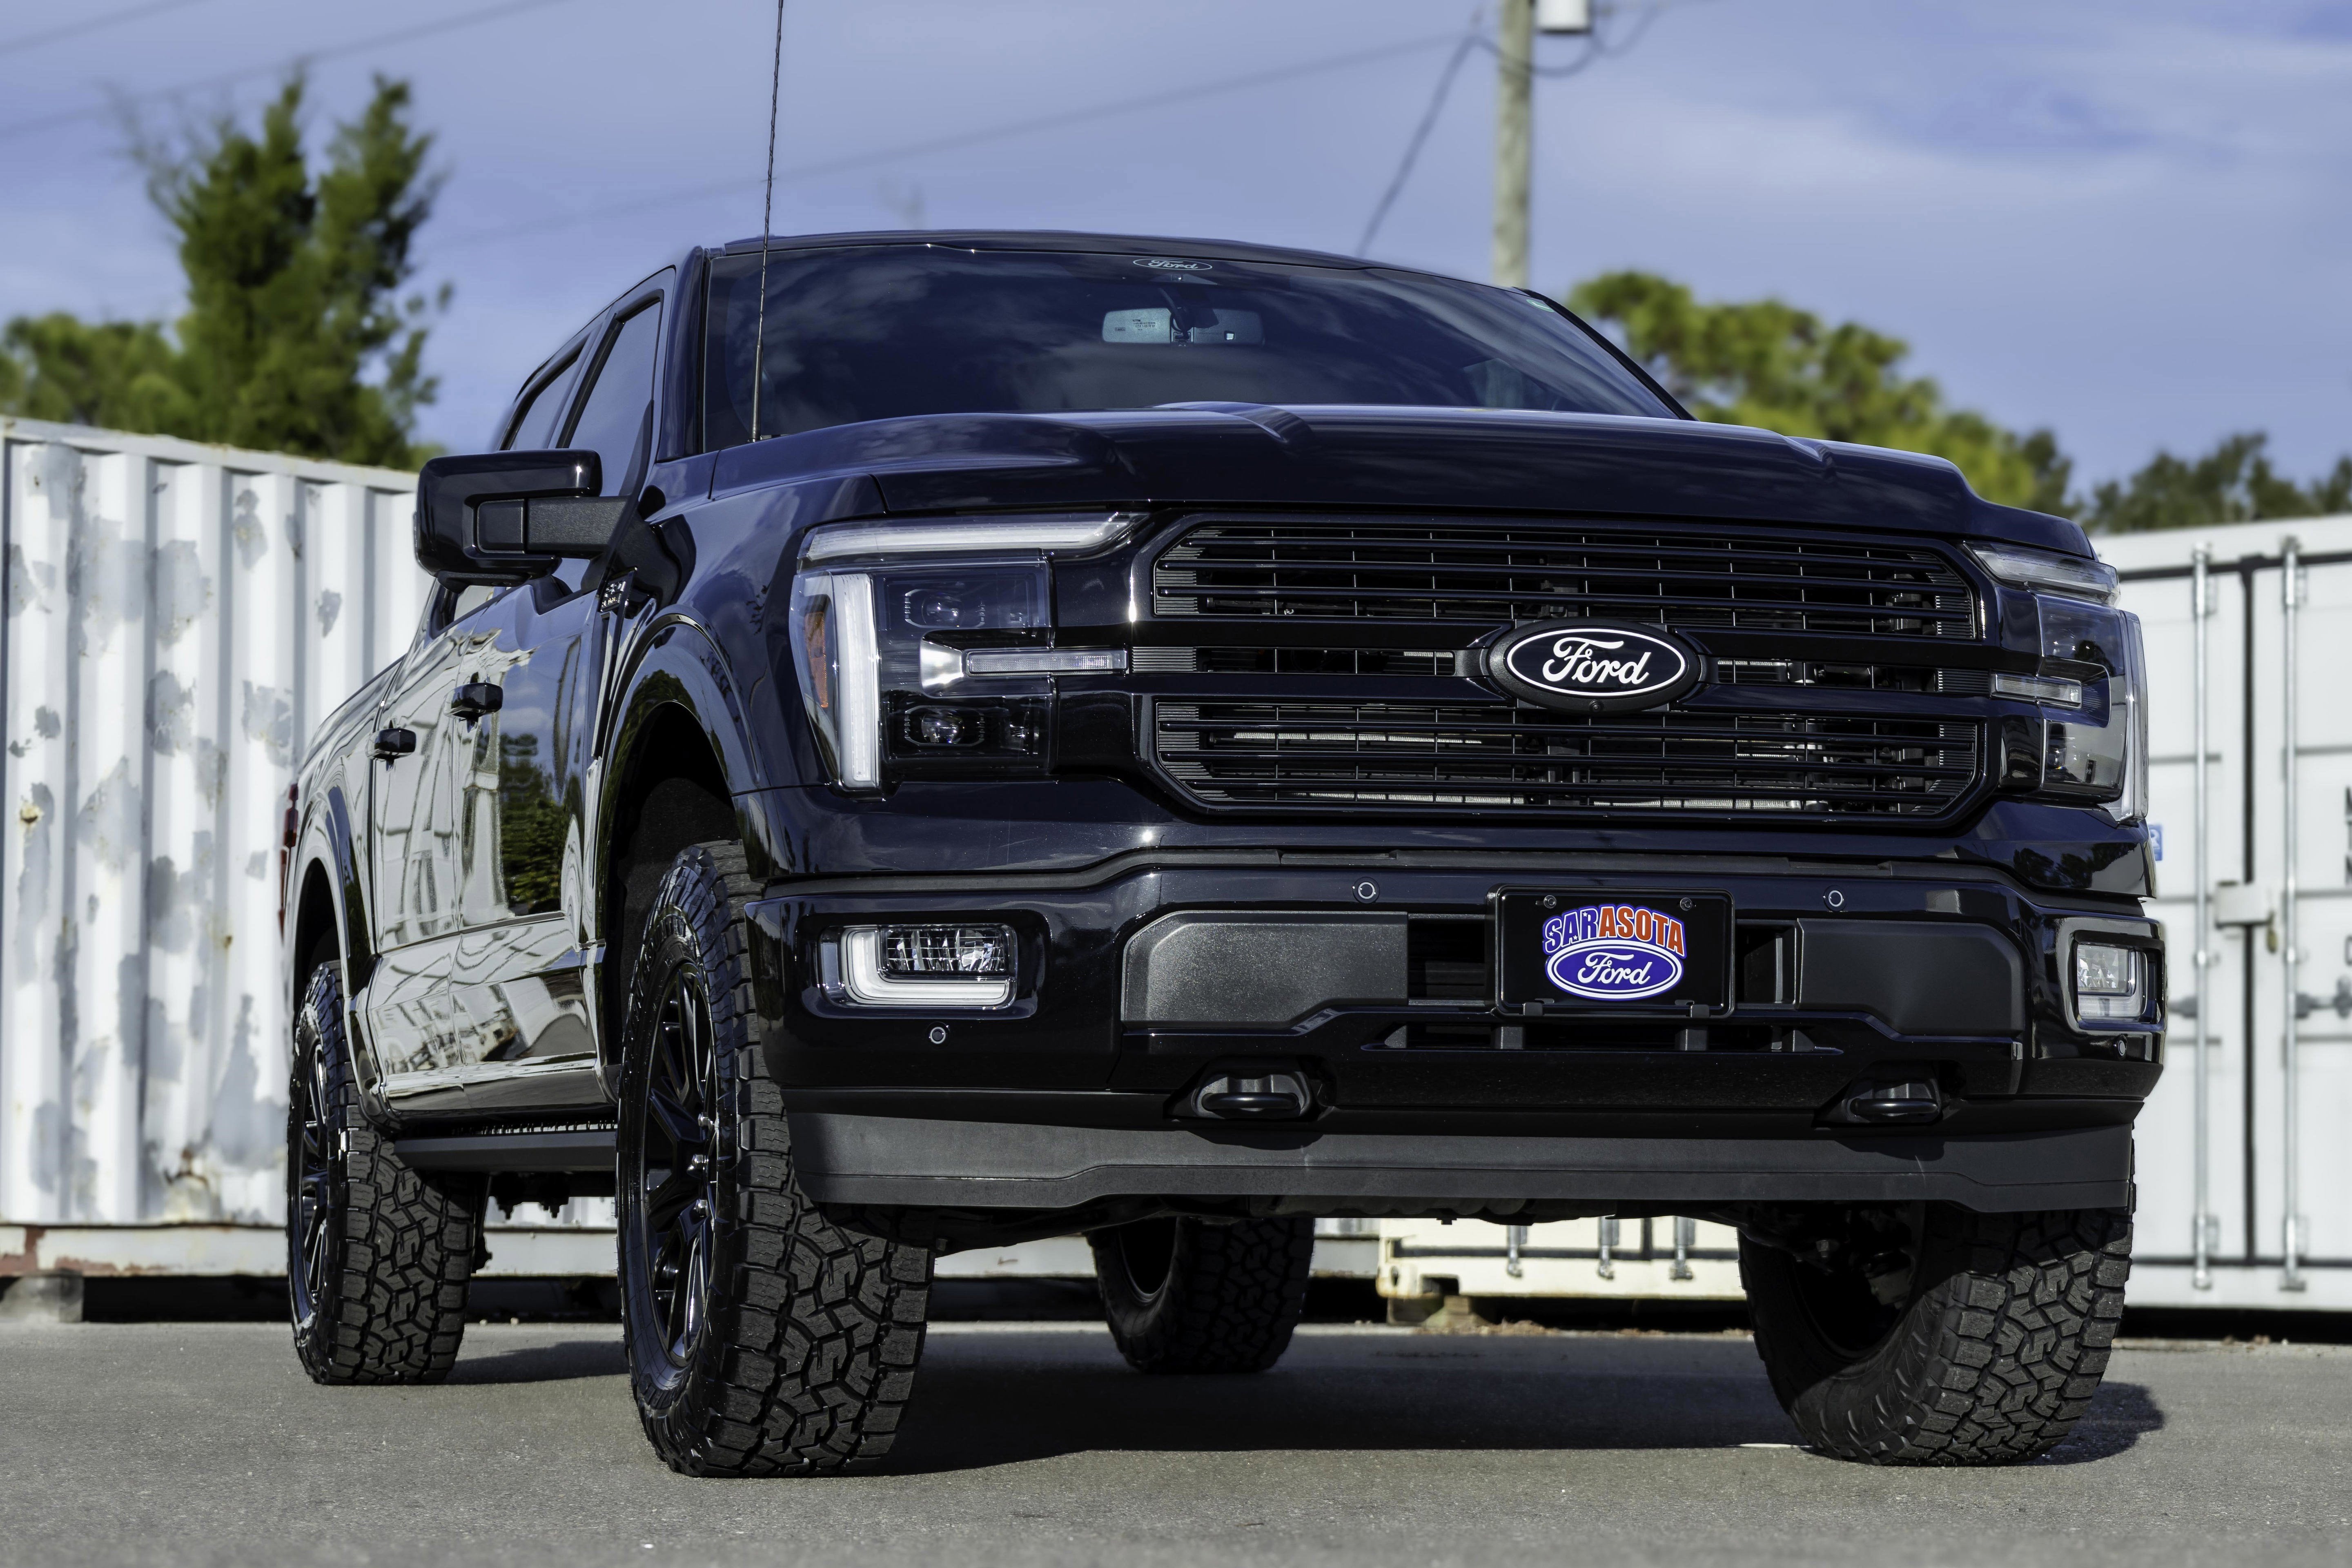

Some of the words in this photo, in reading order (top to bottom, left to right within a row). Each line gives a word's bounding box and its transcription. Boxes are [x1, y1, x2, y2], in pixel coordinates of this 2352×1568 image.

[1148, 259, 1198, 269] Ford
[1542, 637, 1651, 684] Ford
[1544, 905, 1686, 957] SARASOTA
[1577, 952, 1653, 985] Ford
